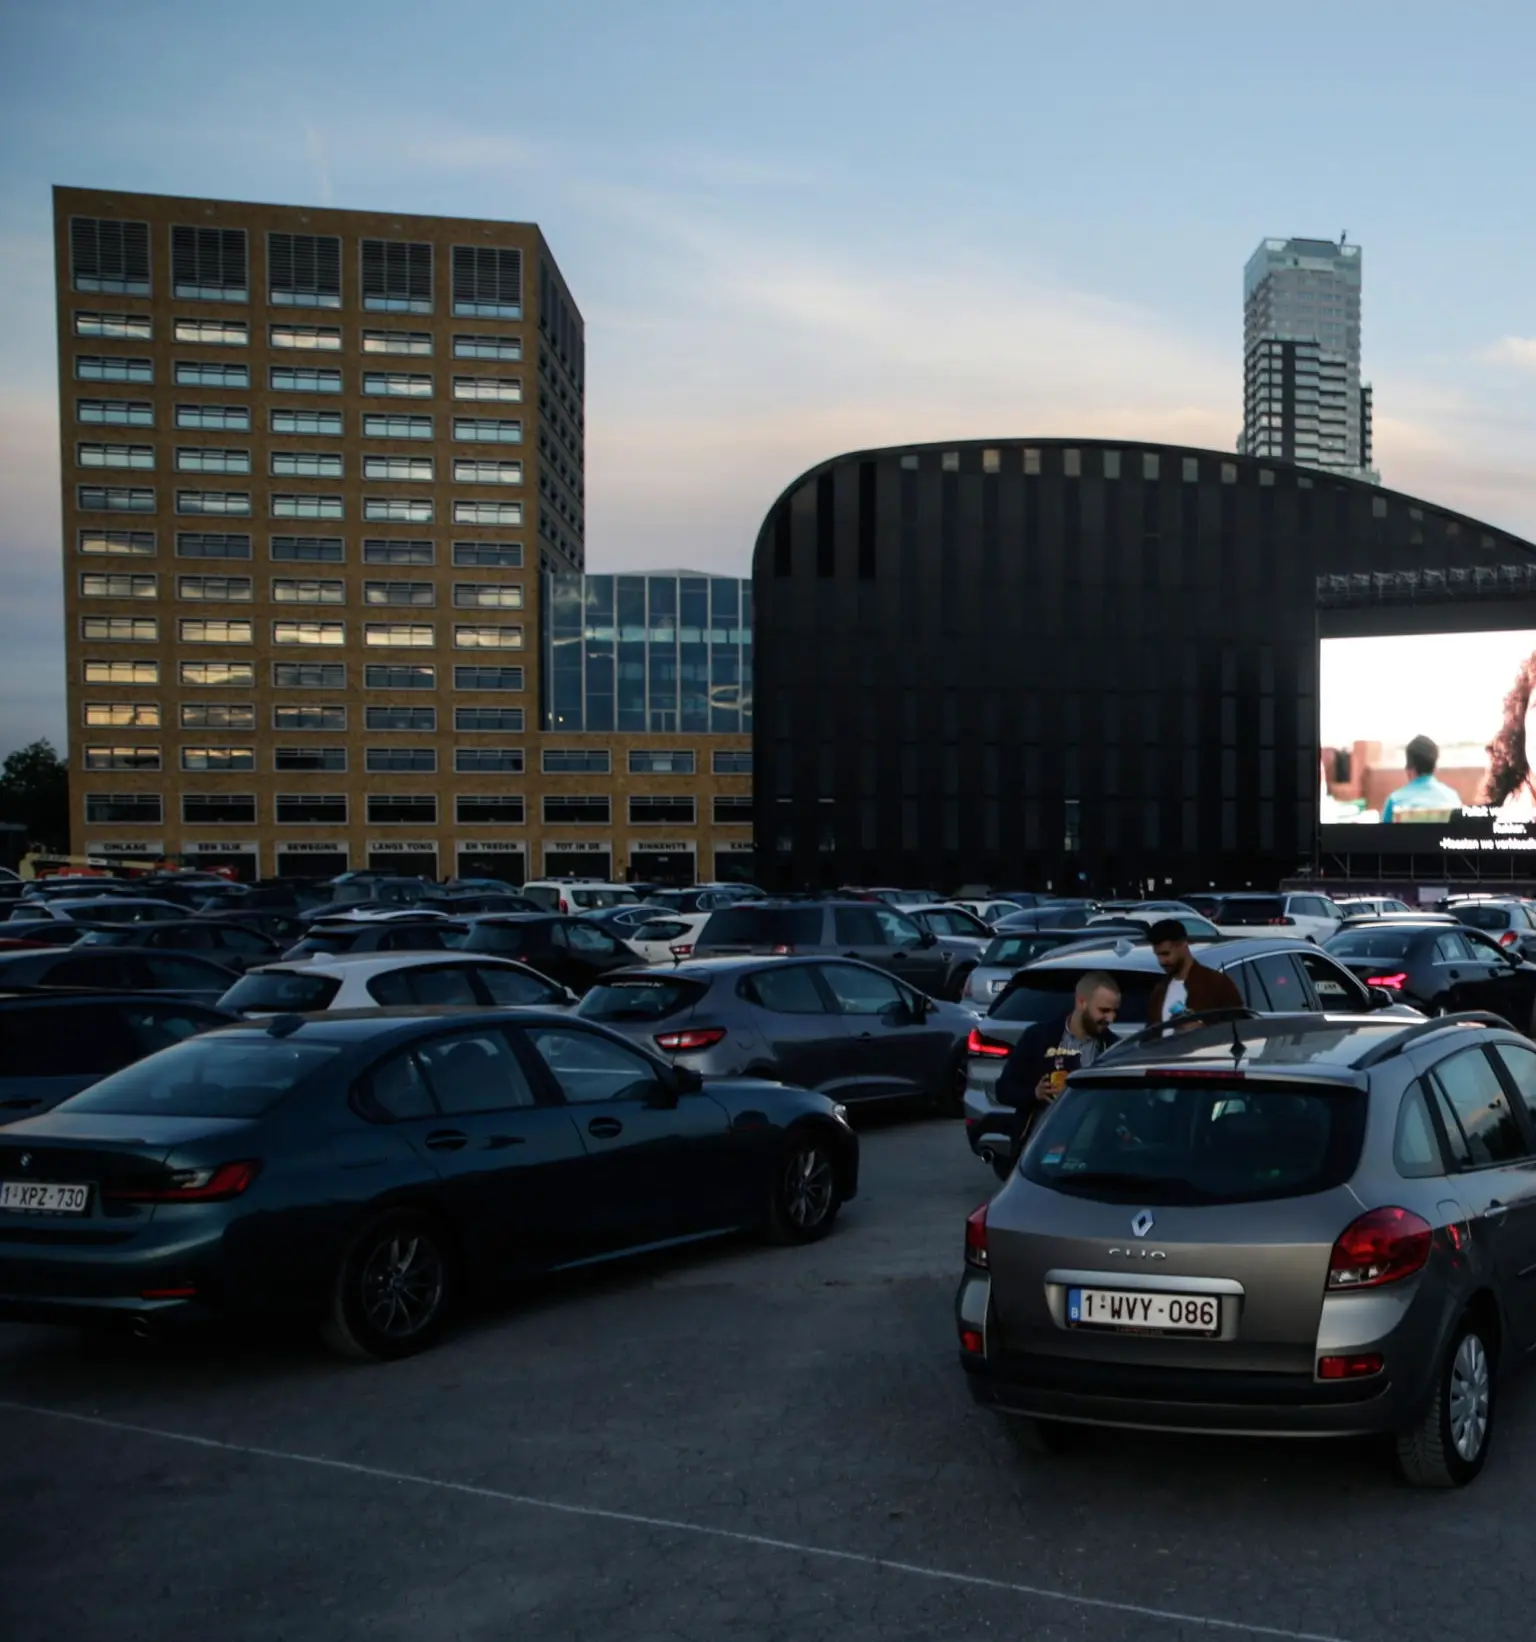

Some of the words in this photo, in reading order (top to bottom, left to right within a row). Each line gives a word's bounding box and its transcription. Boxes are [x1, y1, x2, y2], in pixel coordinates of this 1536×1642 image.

[104, 842, 147, 852] OMLAAG
[287, 843, 338, 851] BEWEGING
[372, 843, 404, 851] LANGS
[407, 843, 434, 851] TONG
[481, 843, 517, 851] TREDEN
[555, 843, 573, 851] TOT
[638, 842, 687, 851] BINNENSTE
[1108, 1247, 1167, 1261] CLIO
